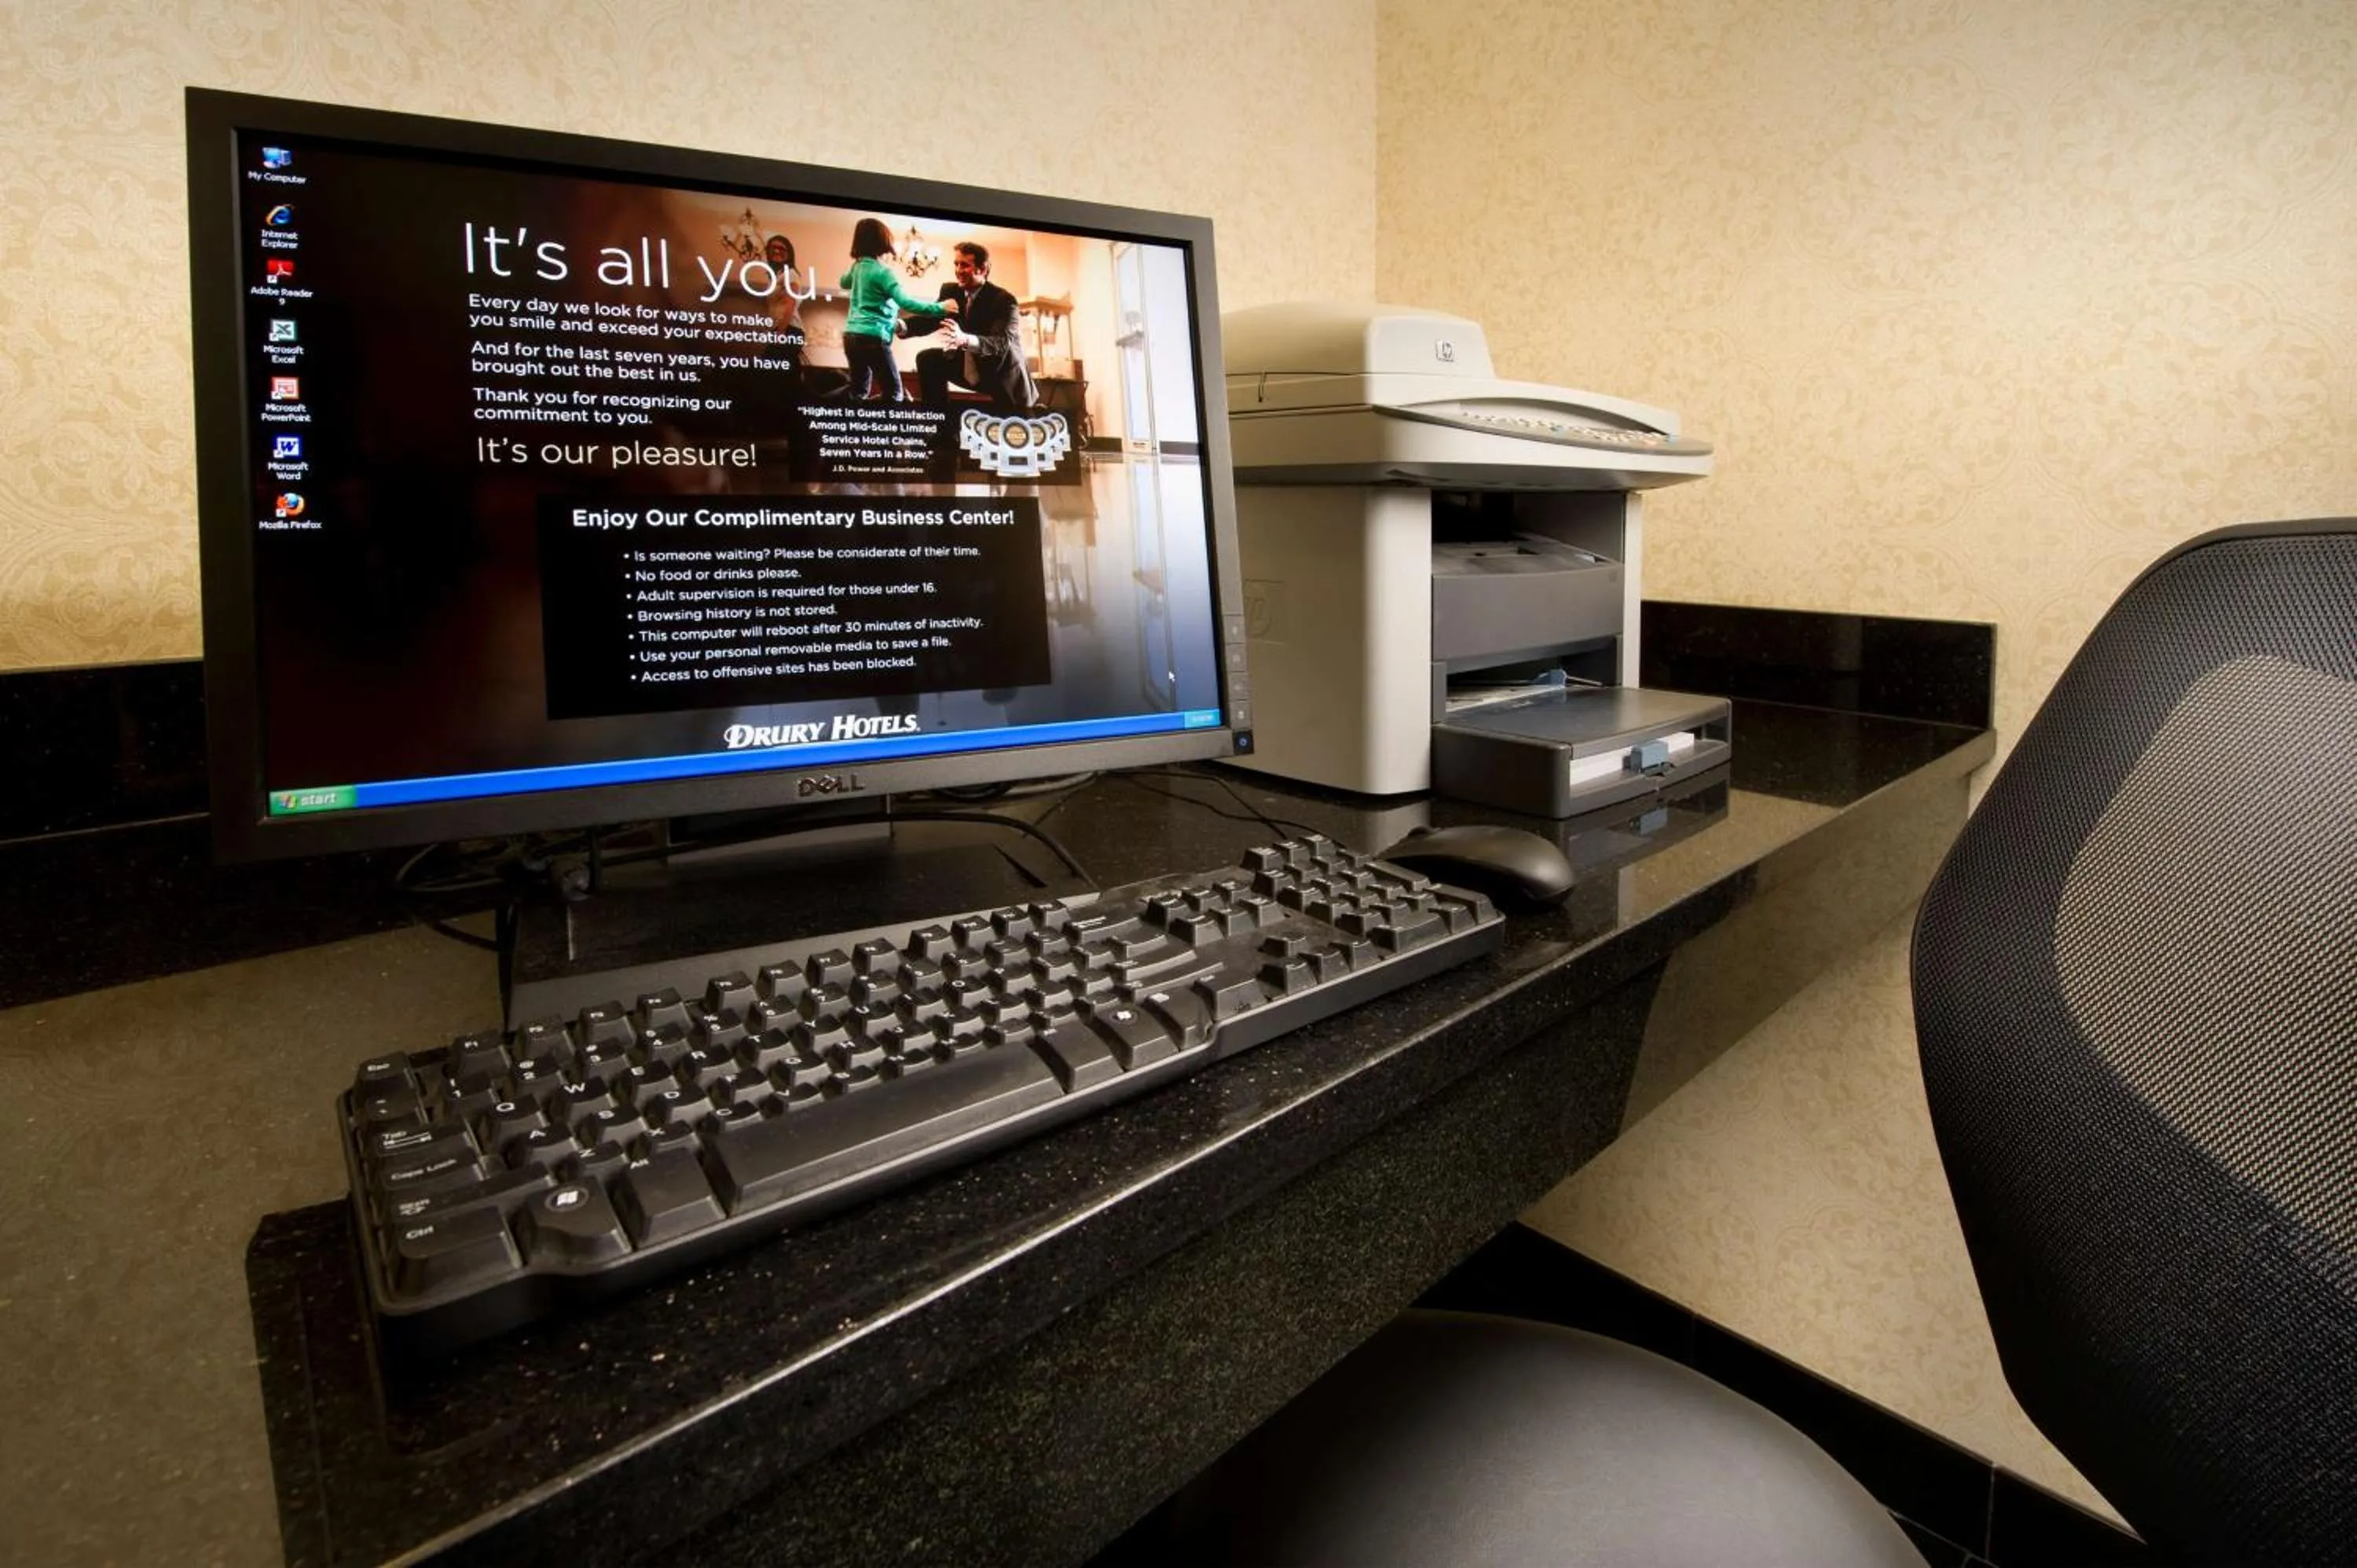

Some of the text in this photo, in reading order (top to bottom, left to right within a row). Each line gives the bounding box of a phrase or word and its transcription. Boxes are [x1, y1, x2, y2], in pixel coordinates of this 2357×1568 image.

[247, 170, 306, 184] My Computer
[261, 229, 298, 240] Internet
[261, 239, 298, 248] Explorer
[465, 222, 833, 302] It's all you.
[251, 286, 313, 297] Adobe Reader
[468, 293, 773, 327] Every day we look for ways to make
[469, 314, 808, 346] you smile and exceed your expectations.
[263, 345, 303, 354] Microsoft
[471, 340, 790, 370] And for the last seven years, you have
[271, 354, 295, 363] Excel
[471, 358, 701, 382] brought out the best in us.
[472, 387, 731, 411] Thank you for recognizing our
[265, 403, 306, 412] Microsoft
[845, 408, 855, 416] in
[856, 408, 886, 418] Guest
[888, 409, 945, 420] Satisfaction
[474, 407, 652, 426] commitment to you.
[808, 421, 937, 433] Among Mid-Scale Limited
[821, 434, 926, 446] Service Hotel Chains,
[478, 437, 756, 468] It's our pleasure!
[819, 447, 851, 457] Seven
[853, 449, 882, 458] Years
[884, 449, 893, 458] in
[276, 471, 301, 480] Word
[290, 520, 321, 529] Firefox
[573, 508, 1014, 529] Enjoy Our Complimentary Business Center!
[634, 546, 981, 561] Is someone waiting? Please be considerate of their time.
[635, 567, 801, 581] No food or drinks please.
[636, 581, 937, 601] Adult supervision is required for those under 16.
[637, 603, 837, 621] Browsing history is not stored.
[638, 617, 983, 641] This computer will reboot after 30 minutes of inactivity.
[640, 636, 951, 662] Use your personal removable media to save a file.
[641, 656, 916, 682] Access to offensive sites has been blocked.
[724, 723, 826, 749] DRURY
[796, 773, 864, 797] DELL
[301, 793, 336, 806] start
